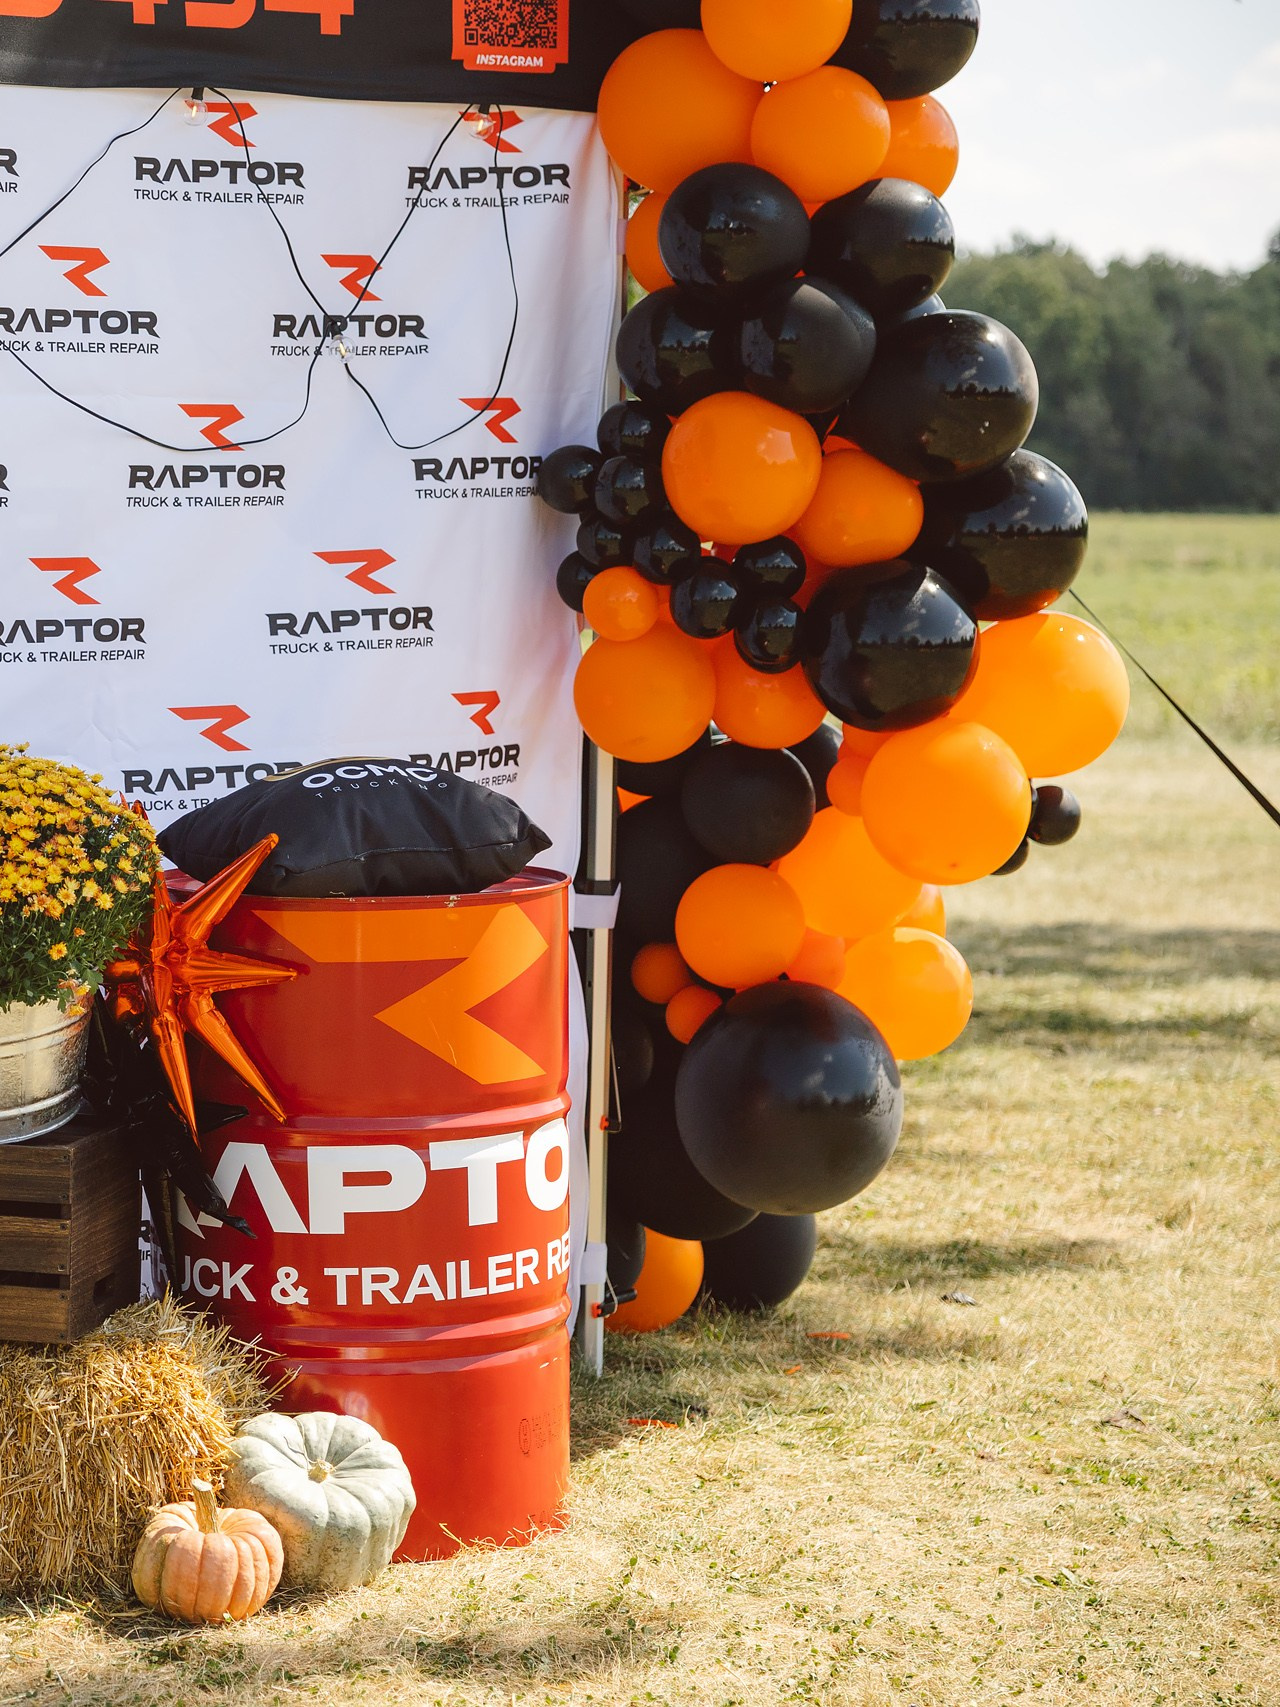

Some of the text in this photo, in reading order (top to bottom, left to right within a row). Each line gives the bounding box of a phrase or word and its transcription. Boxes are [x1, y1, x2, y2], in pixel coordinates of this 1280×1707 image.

[475, 54, 544, 67] INSTAGRAM
[134, 157, 305, 191] RAPTOR
[407, 164, 571, 192] RAPTOR
[133, 188, 305, 207] TRUCK & TRAILER REPAIR
[404, 193, 570, 209] TRUCK & TRAILER REPAIR
[34, 341, 45, 352] &
[47, 341, 106, 354] TRAILER
[109, 342, 159, 355] REPAIR
[129, 465, 285, 491] RAPTOR
[125, 495, 285, 508] TRUCK & TRAILER REPAIR
[265, 607, 434, 638] RAPTOR
[26, 651, 37, 663] &
[39, 650, 98, 663] TRAILER
[100, 649, 146, 661] REPAIR
[269, 636, 434, 655] TRUCK & TRAILER REPAIR
[302, 764, 438, 789] OCMC
[178, 1118, 571, 1239] APTO
[270, 1266, 309, 1305] &
[324, 1248, 540, 1306] TRAILER
